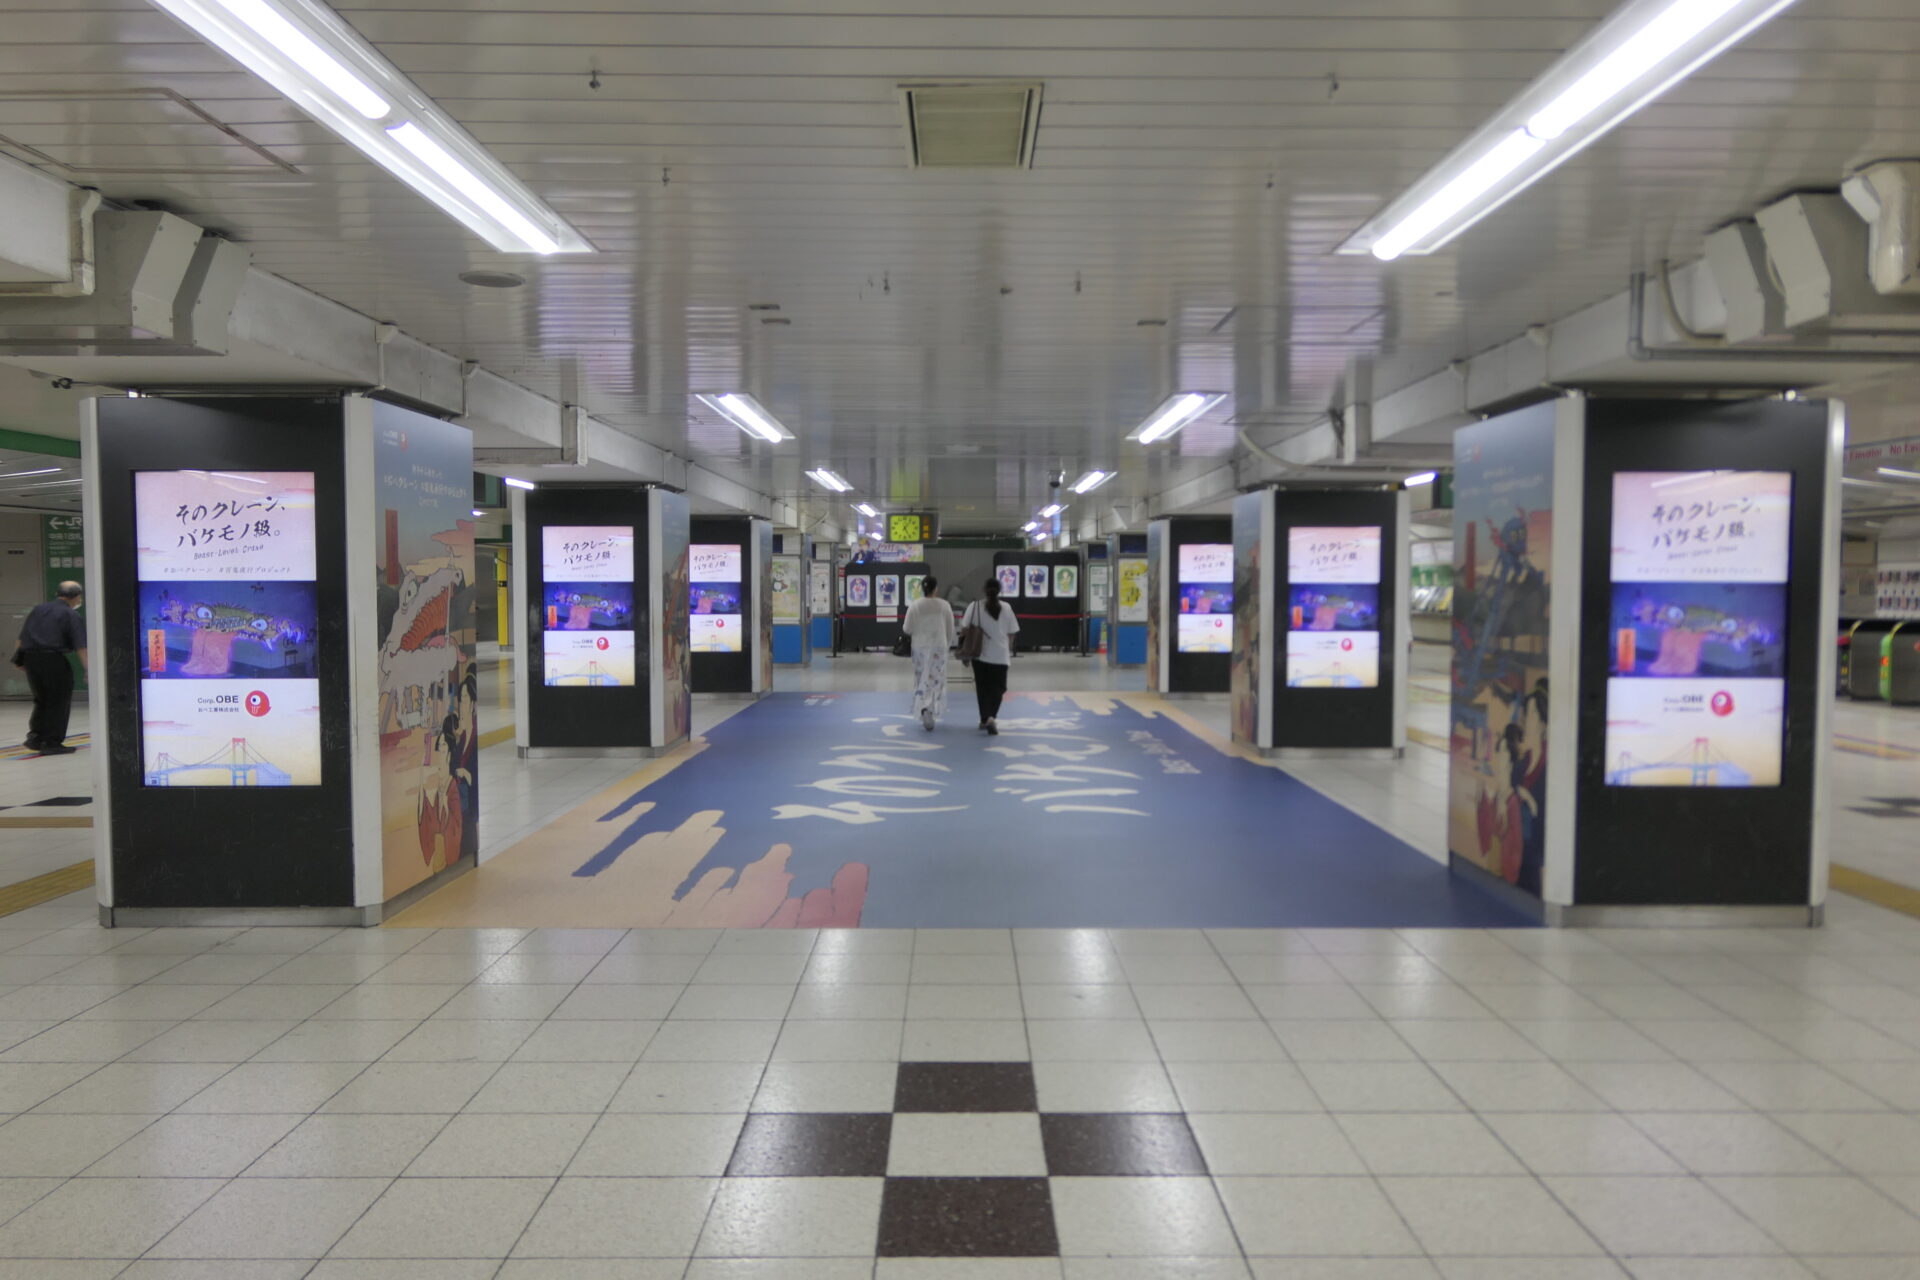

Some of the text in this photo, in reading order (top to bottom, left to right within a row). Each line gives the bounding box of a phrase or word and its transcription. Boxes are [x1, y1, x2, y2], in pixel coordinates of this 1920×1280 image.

[65, 517, 82, 527] JR
[176, 496, 286, 525] そのクレーン、
[1652, 497, 1761, 525] そのクレーン、
[177, 520, 281, 548] バケモノ級。
[216, 695, 239, 704] OBE
